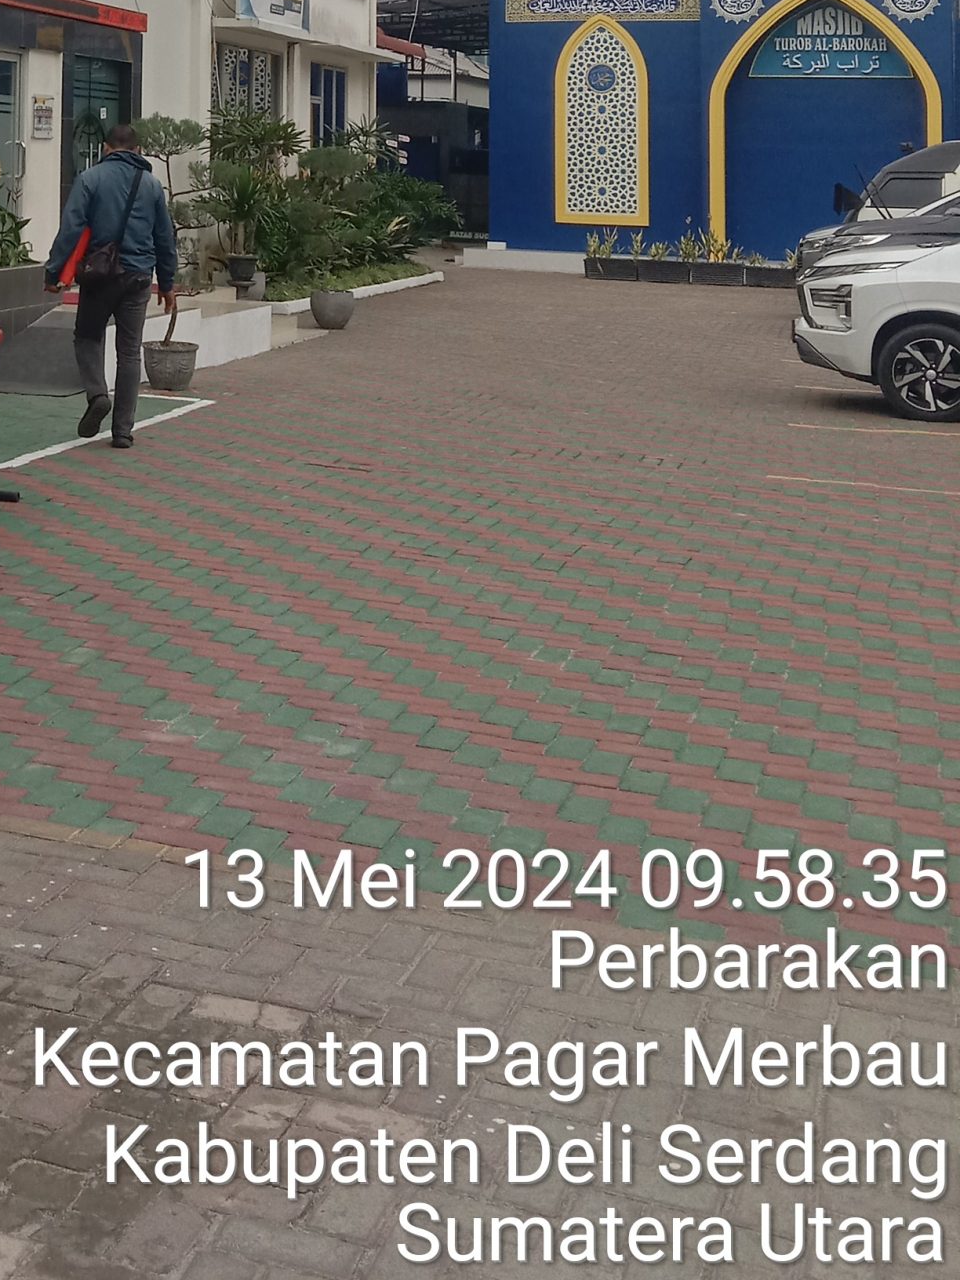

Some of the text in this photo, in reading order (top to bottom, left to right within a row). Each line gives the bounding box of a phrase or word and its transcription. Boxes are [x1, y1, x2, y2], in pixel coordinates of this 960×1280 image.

[797, 6, 863, 36] MASJID
[774, 37, 887, 52] TUROB AL-BAROKAH
